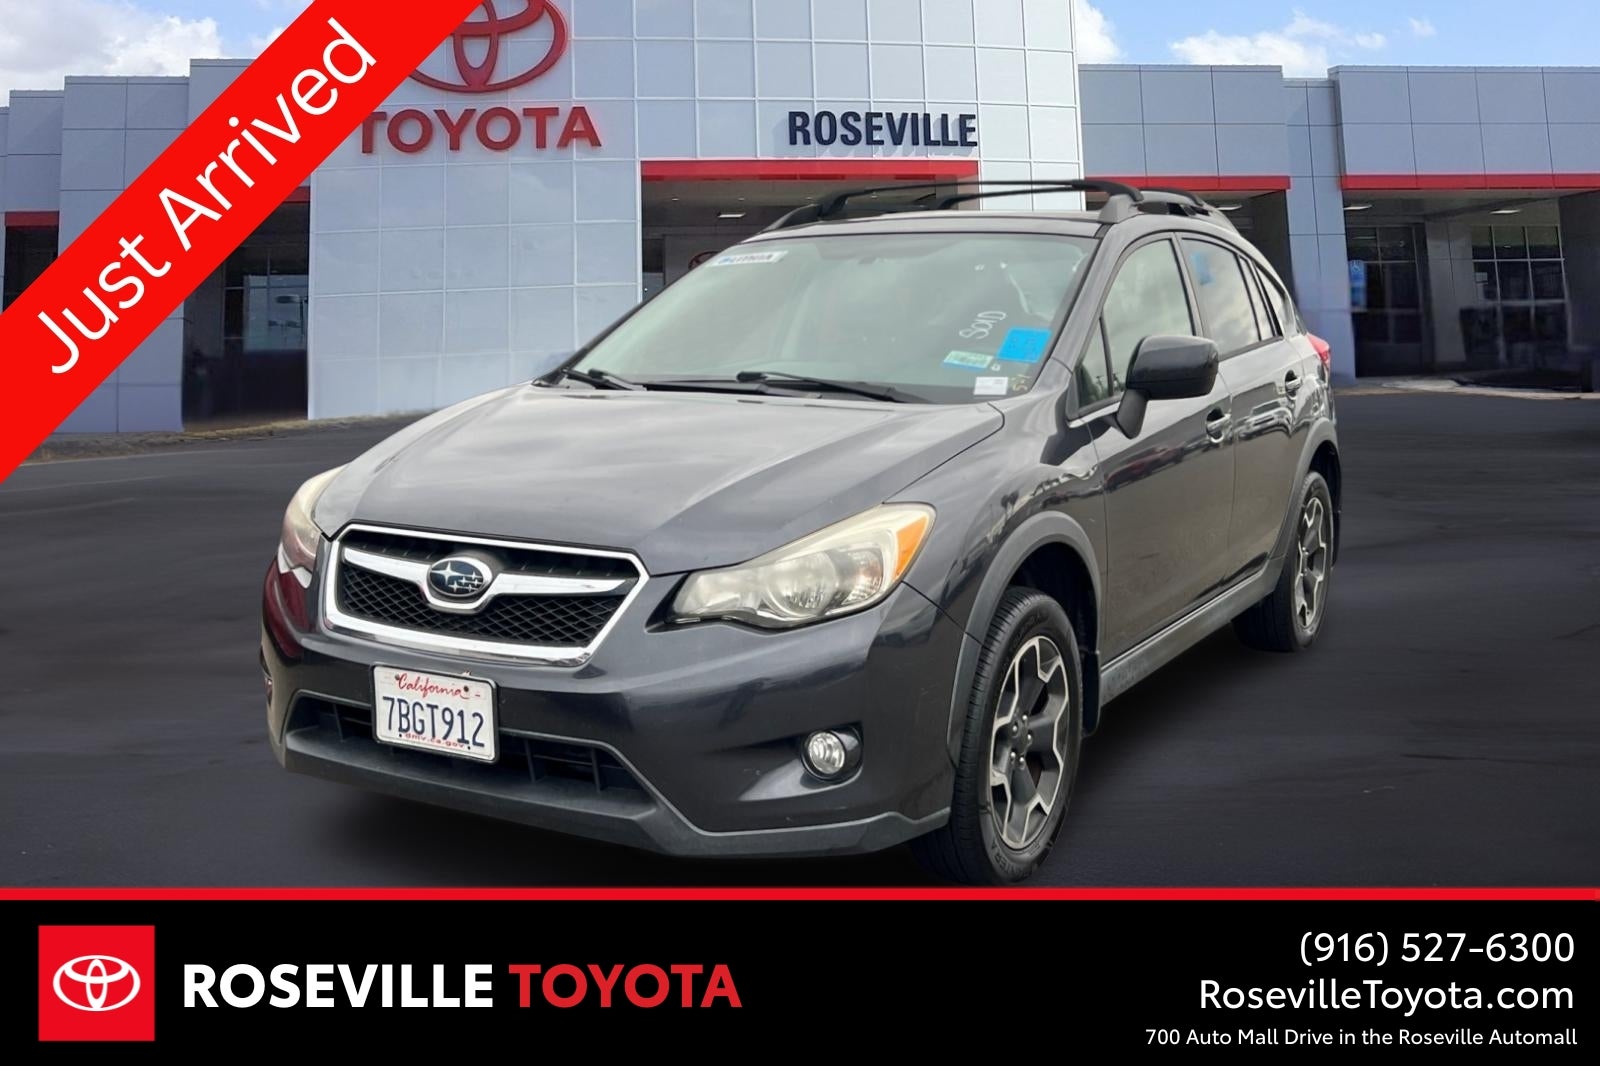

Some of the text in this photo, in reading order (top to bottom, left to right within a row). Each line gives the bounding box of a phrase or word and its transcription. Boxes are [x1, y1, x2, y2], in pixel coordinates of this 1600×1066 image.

[362, 106, 602, 154] TOYOTA
[788, 110, 978, 147] ROSEVILLE
[397, 673, 463, 698] California
[382, 695, 485, 748] 7BGT912
